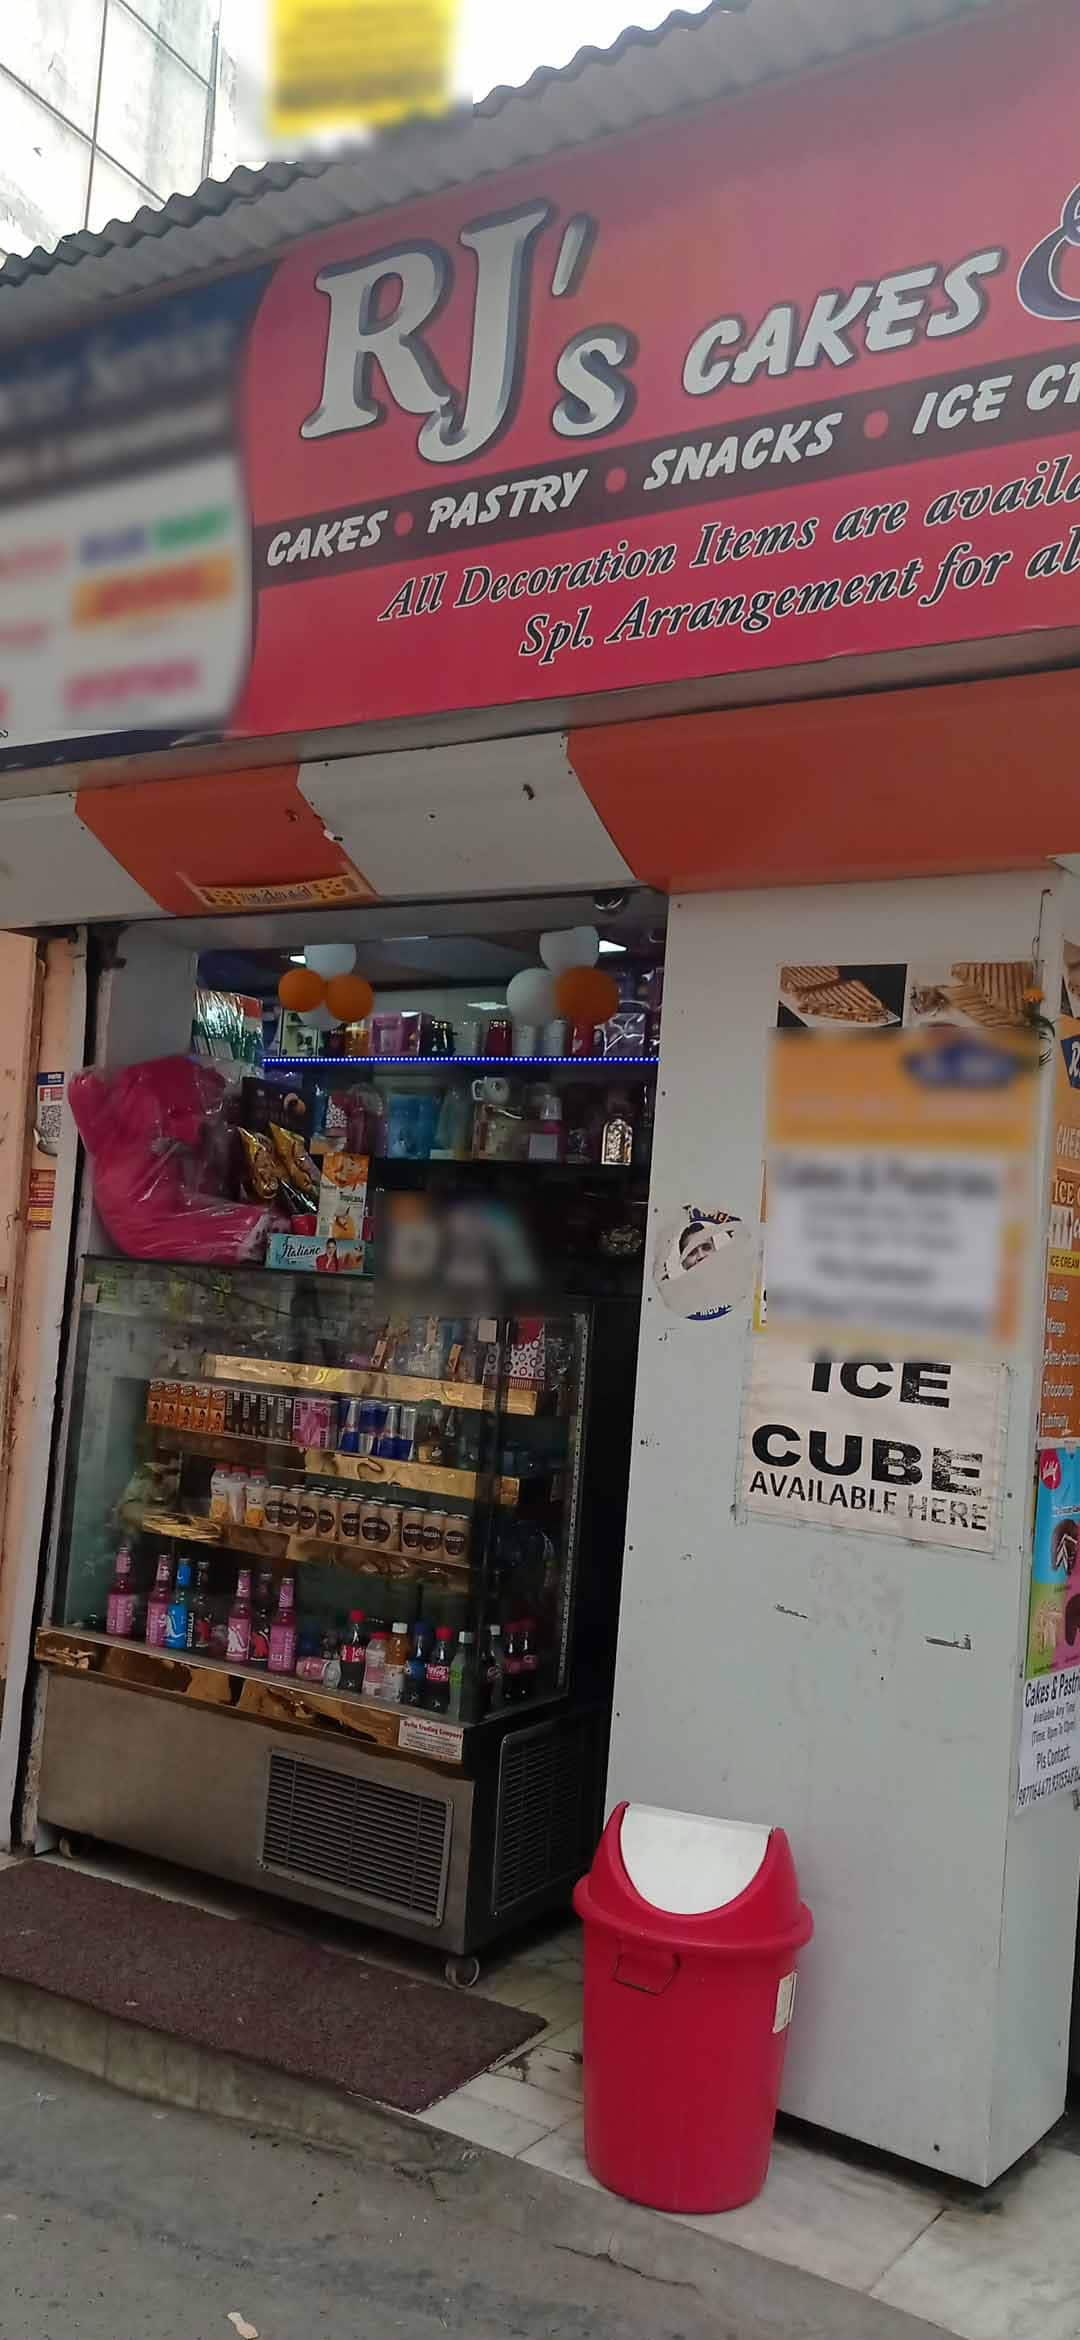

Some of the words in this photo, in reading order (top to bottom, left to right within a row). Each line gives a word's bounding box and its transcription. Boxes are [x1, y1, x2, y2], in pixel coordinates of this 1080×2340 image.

[300, 200, 637, 466] RJ's
[682, 247, 1007, 396] CAKES
[266, 510, 389, 567] CAKES
[427, 469, 589, 534] PASTRY
[643, 412, 844, 491] SNACKS
[912, 375, 1014, 435] ICE
[377, 572, 444, 621] All
[455, 540, 677, 609] Decoration
[689, 516, 818, 568] Items
[832, 499, 910, 543] are
[519, 608, 595, 665] Spl.
[605, 557, 923, 645] Arrangement
[919, 543, 1014, 606] for
[811, 1352, 951, 1408] ICE
[750, 1471, 898, 1515] AVAILABLE
[907, 1493, 988, 1531] HERE
[752, 1424, 983, 1497] CUBE
[1025, 1681, 1049, 1707] Cakes
[1051, 1675, 1058, 1700] &
